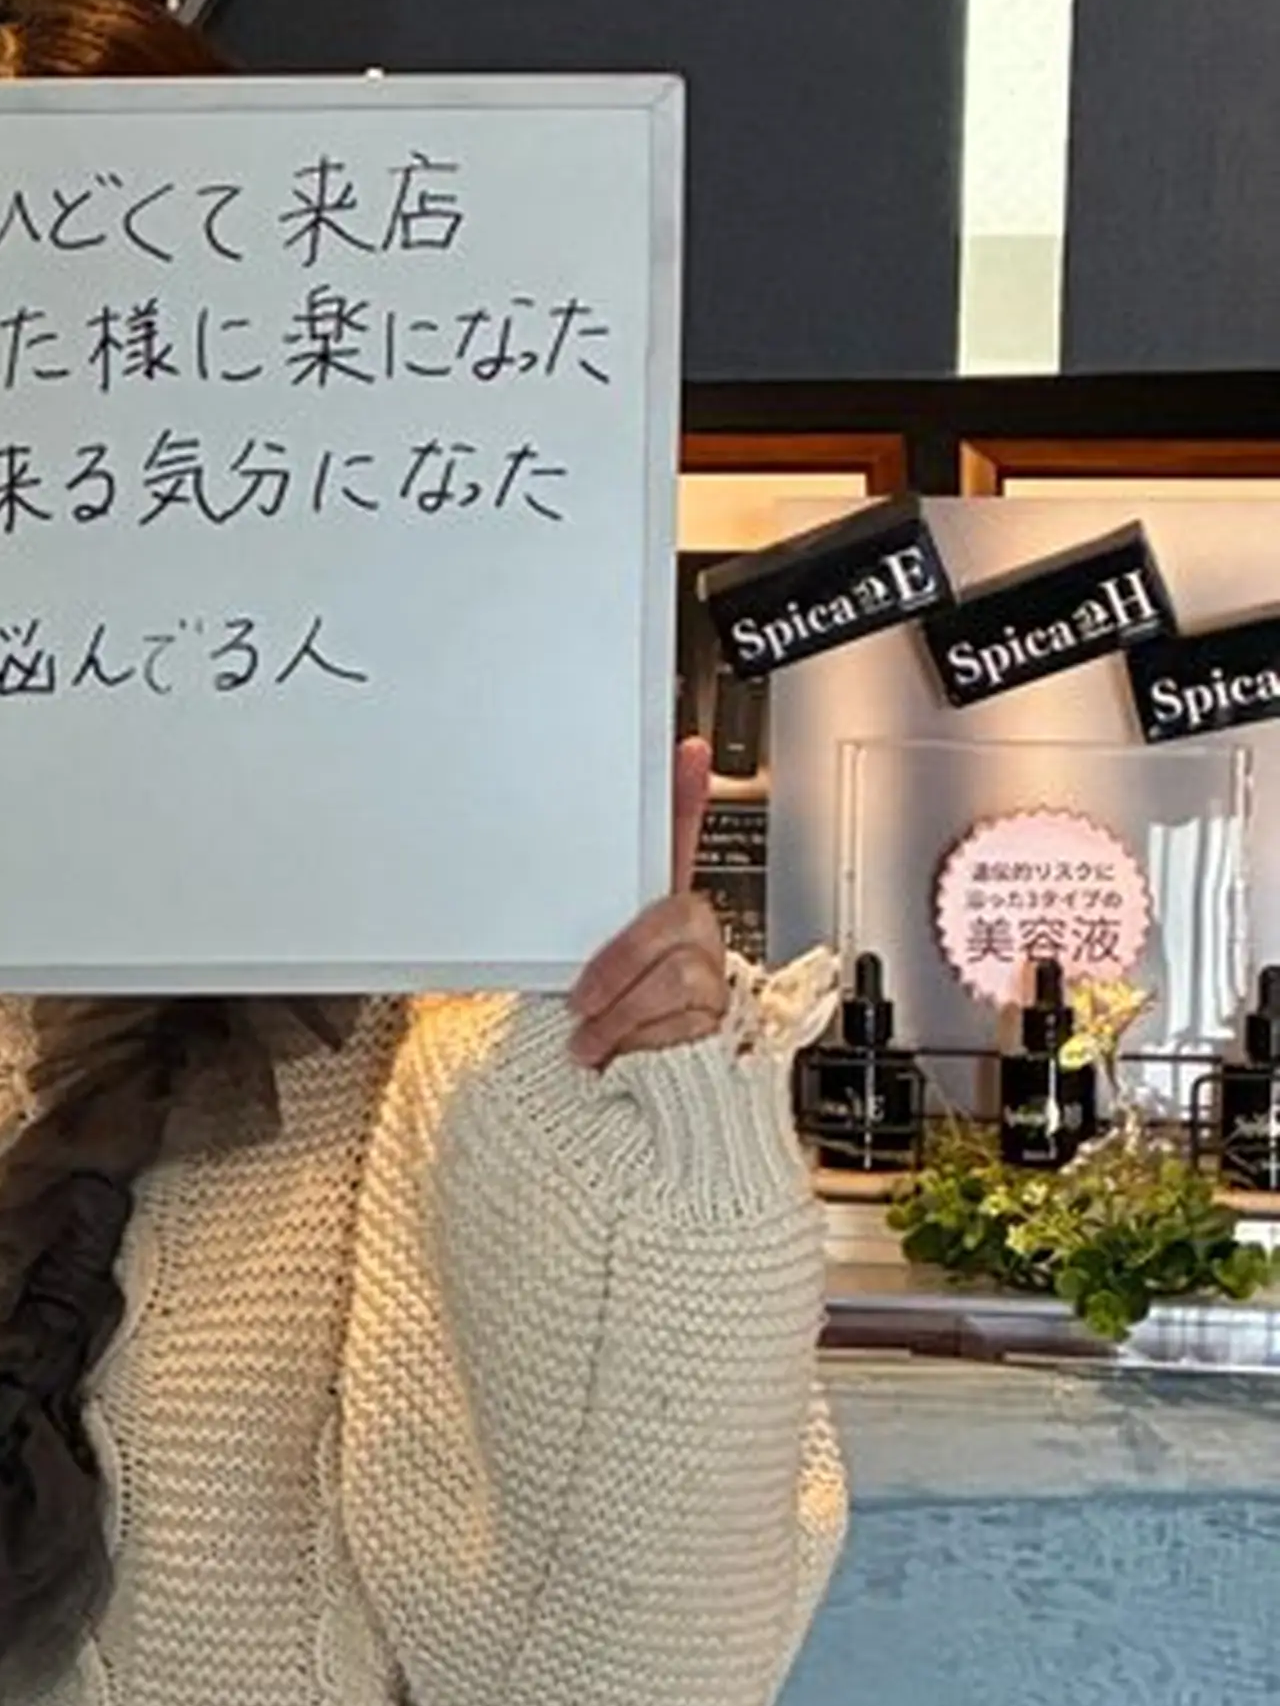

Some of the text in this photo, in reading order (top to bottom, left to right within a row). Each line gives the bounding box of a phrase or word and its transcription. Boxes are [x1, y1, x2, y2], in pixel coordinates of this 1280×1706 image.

[1150, 667, 1280, 730] Spica
[966, 914, 1123, 964] 美容液
